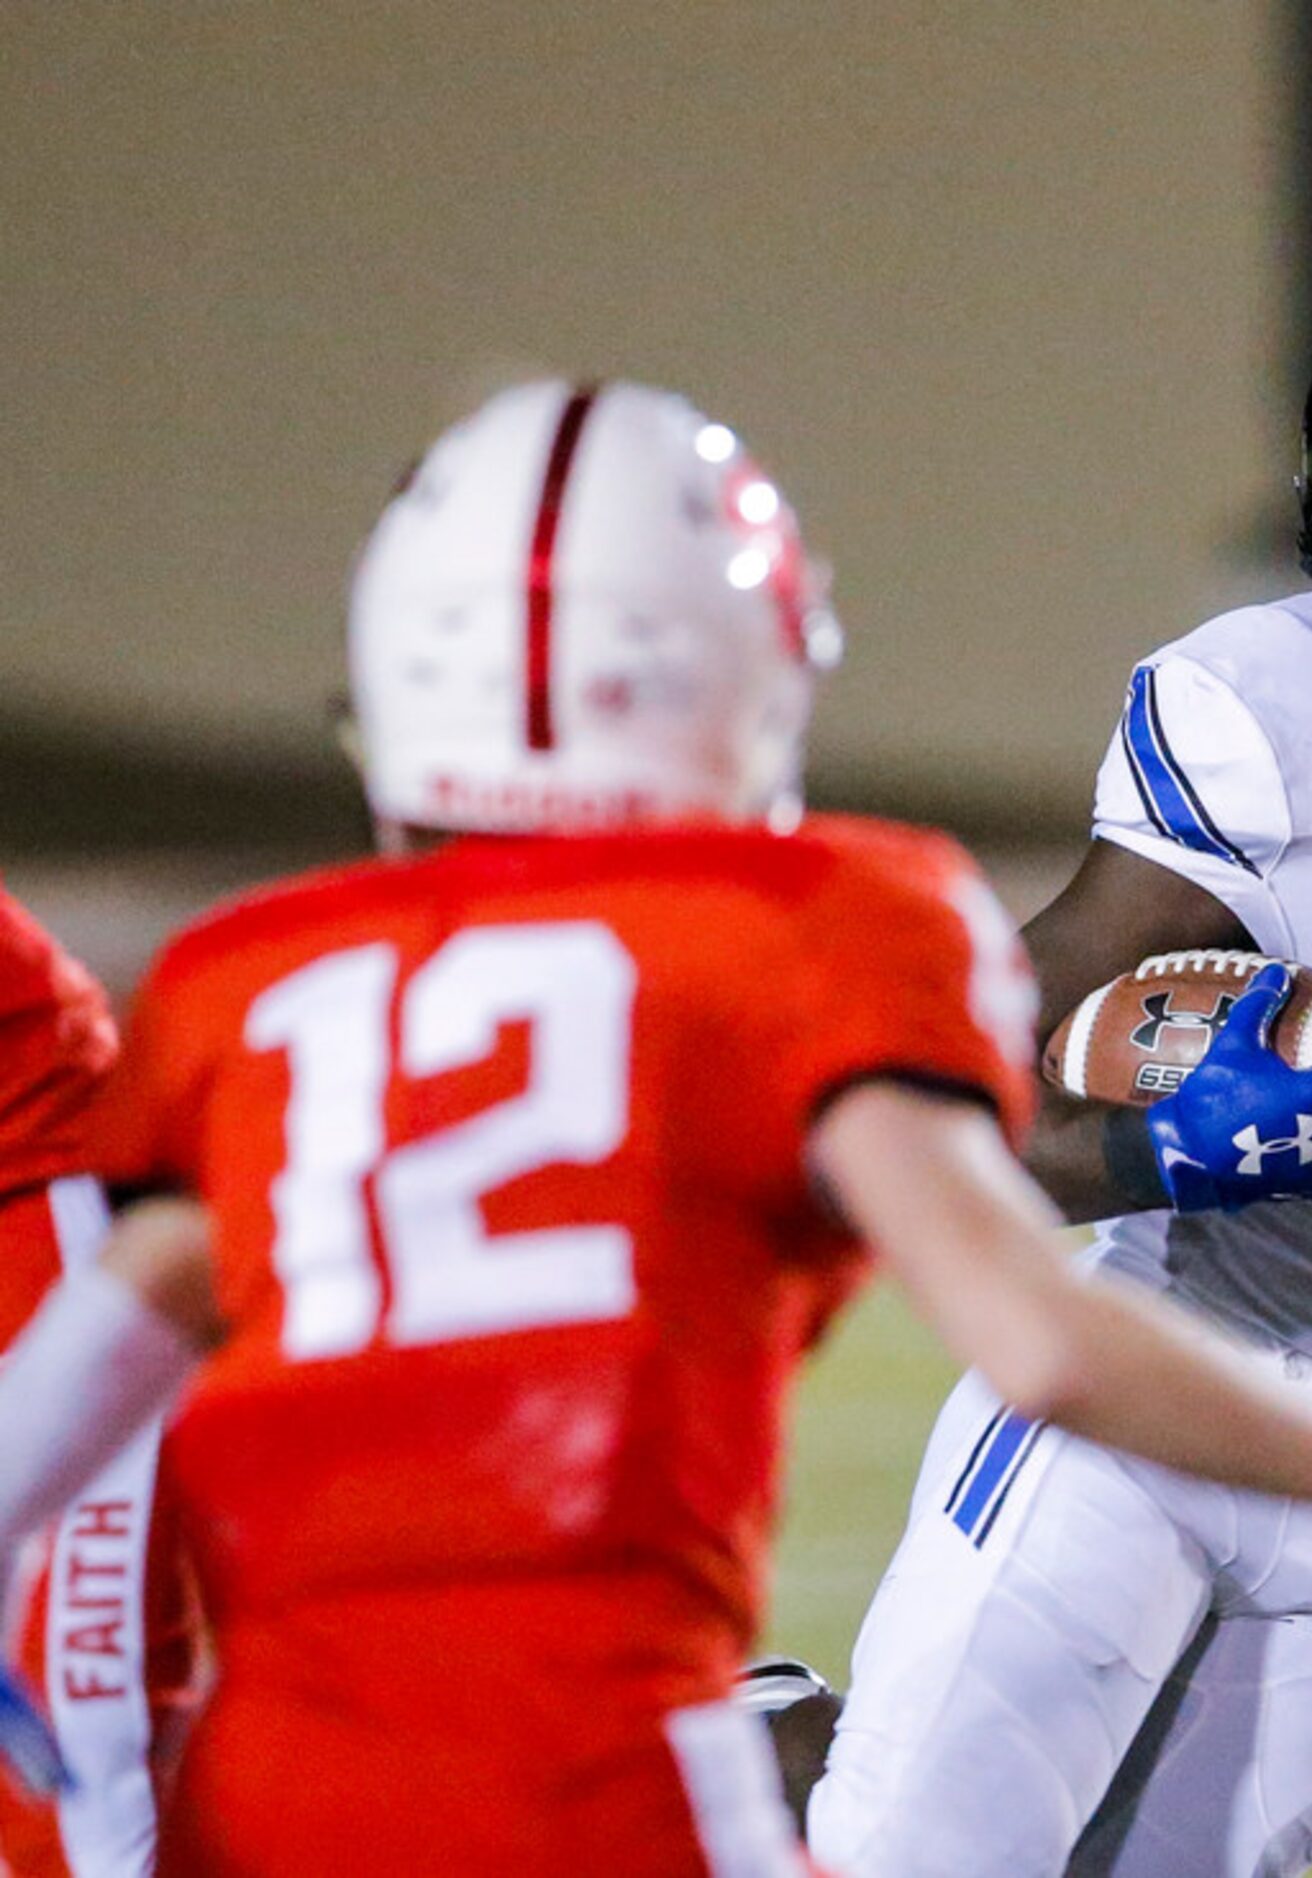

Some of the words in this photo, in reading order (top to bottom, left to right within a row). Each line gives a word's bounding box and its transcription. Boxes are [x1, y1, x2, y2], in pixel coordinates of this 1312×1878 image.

[243, 918, 638, 1364] 12
[1139, 1067, 1185, 1090] 69
[63, 1502, 132, 1701] FAITH
